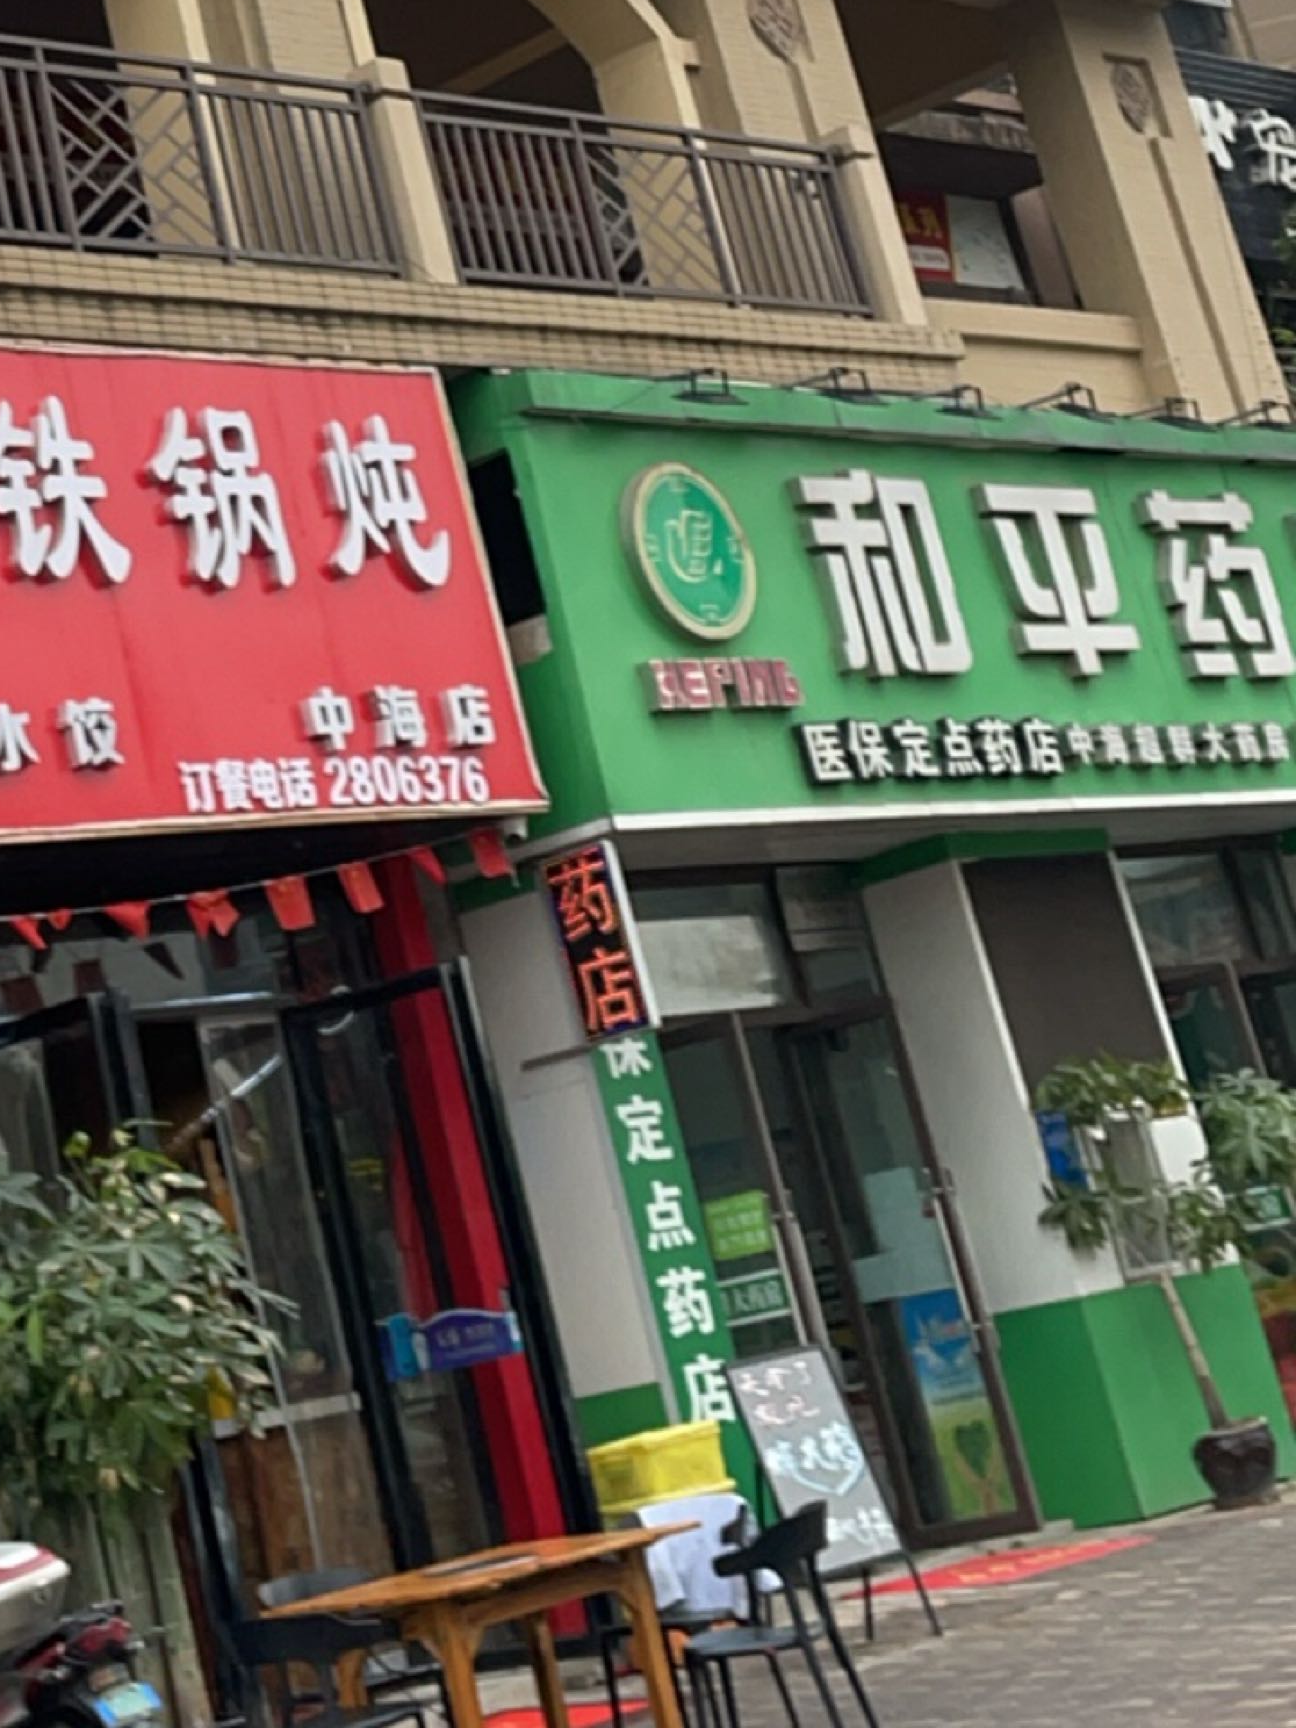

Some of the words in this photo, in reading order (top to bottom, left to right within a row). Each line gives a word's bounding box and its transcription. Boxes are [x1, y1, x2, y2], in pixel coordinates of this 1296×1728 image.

[307, 684, 496, 752] 中海店
[804, 718, 1064, 782] 医保定点药店
[178, 756, 319, 813] 订餐电话
[324, 755, 491, 806] 2806376
[549, 845, 646, 1037] 药店
